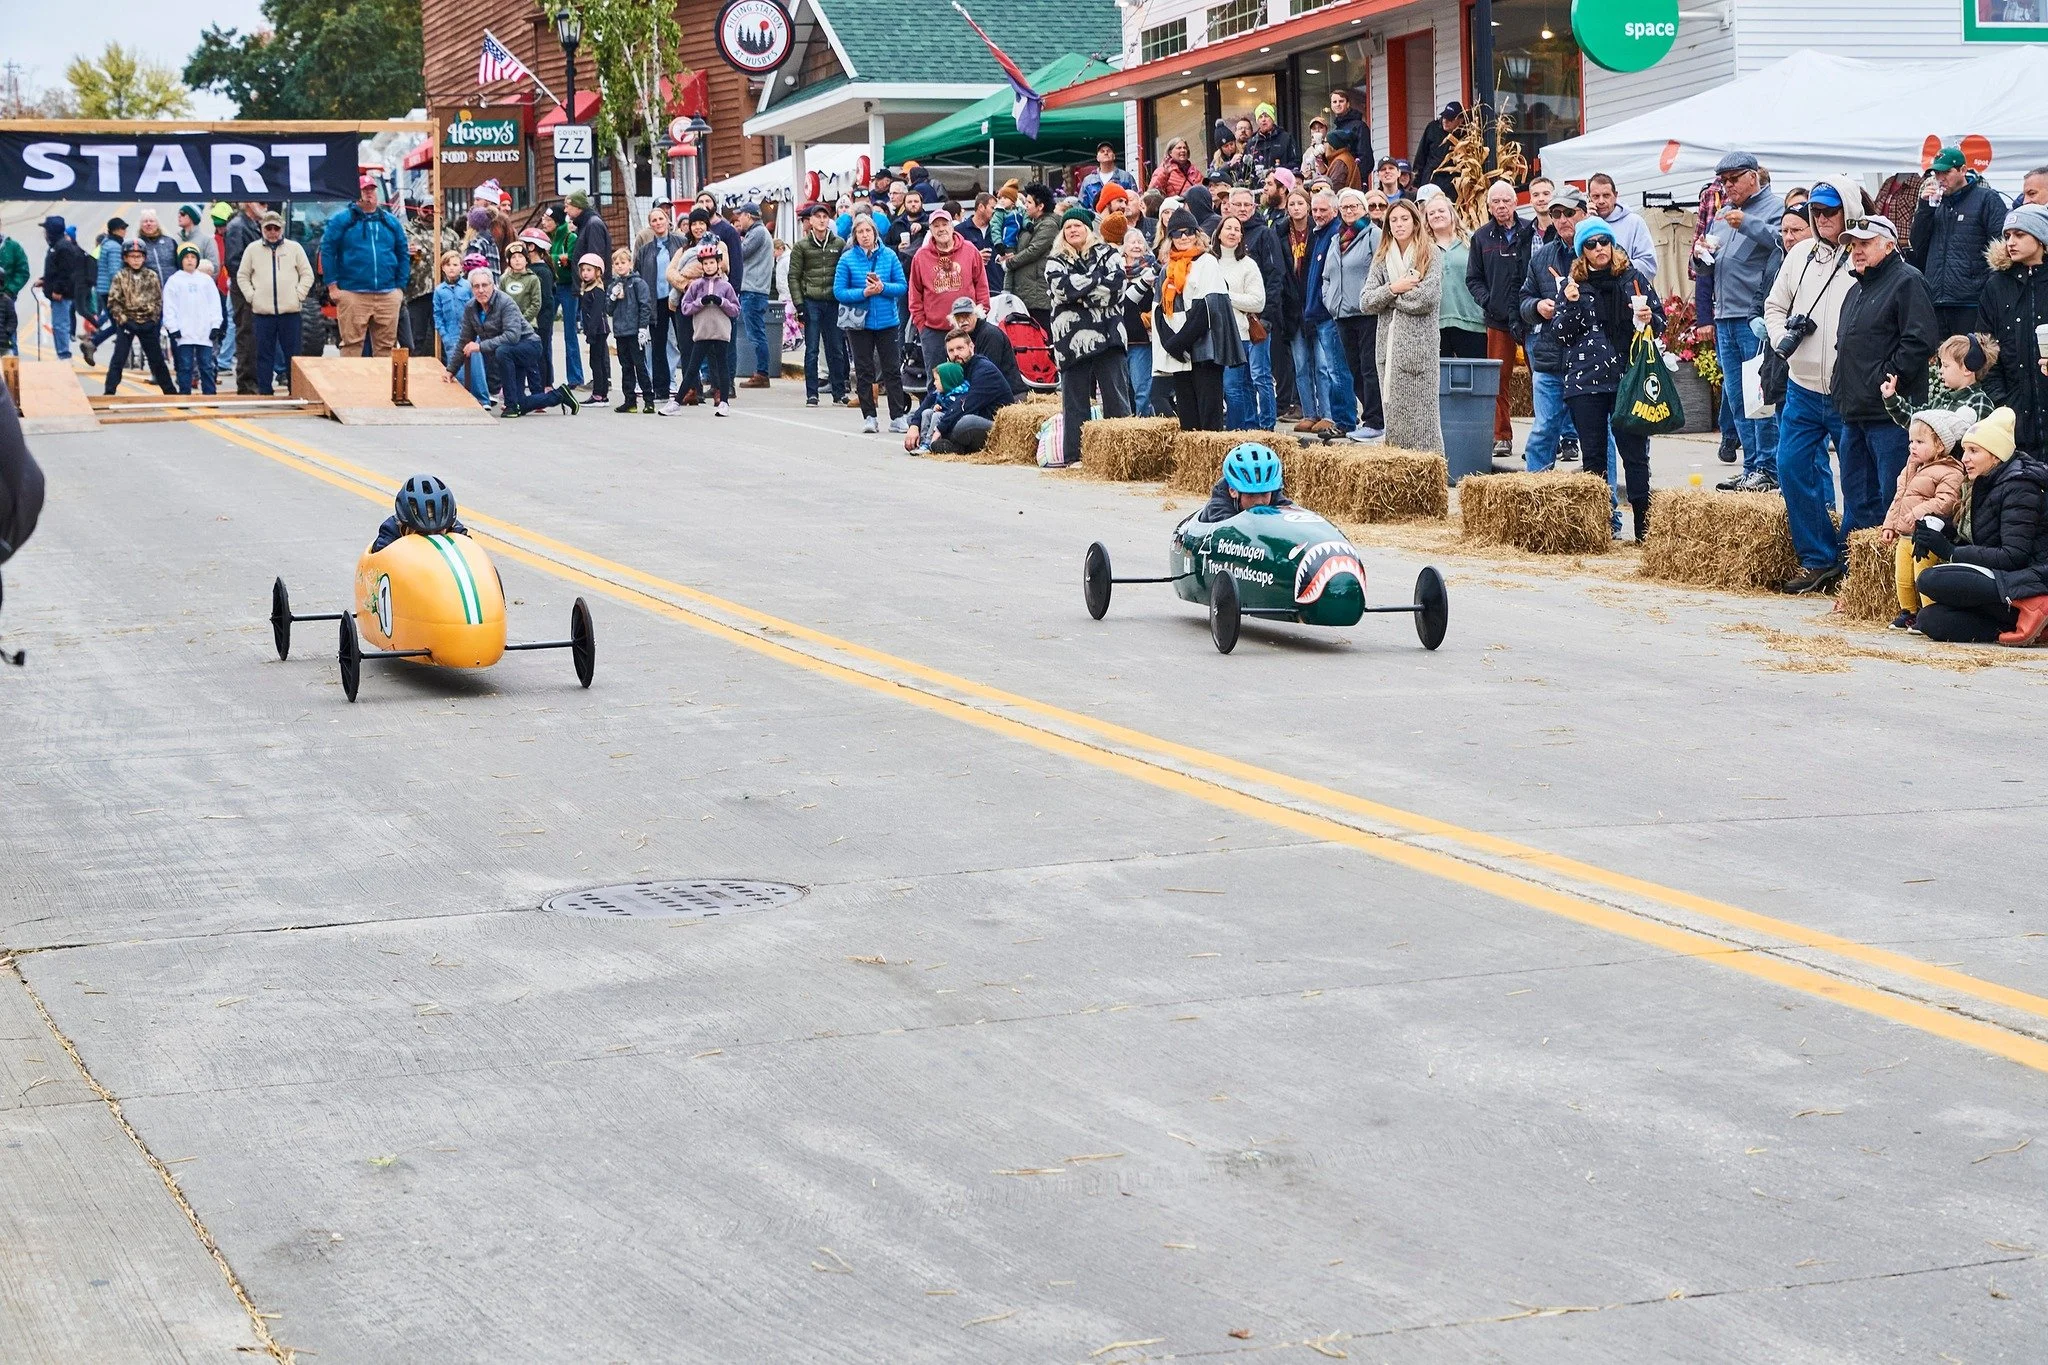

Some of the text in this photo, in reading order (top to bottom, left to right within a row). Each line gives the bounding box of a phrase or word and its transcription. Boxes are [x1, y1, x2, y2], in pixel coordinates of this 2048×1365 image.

[727, 3, 784, 29] FILLING STATION
[1624, 22, 1675, 41] space
[734, 49, 778, 66] AT HUSBY'S
[559, 137, 585, 154] ZZ
[440, 150, 468, 164] FOOD
[475, 149, 520, 163] SPIRITS
[1973, 158, 1990, 167] spot
[21, 141, 328, 194] START
[1217, 538, 1266, 563] Bridenhagen
[381, 586, 388, 628] 1
